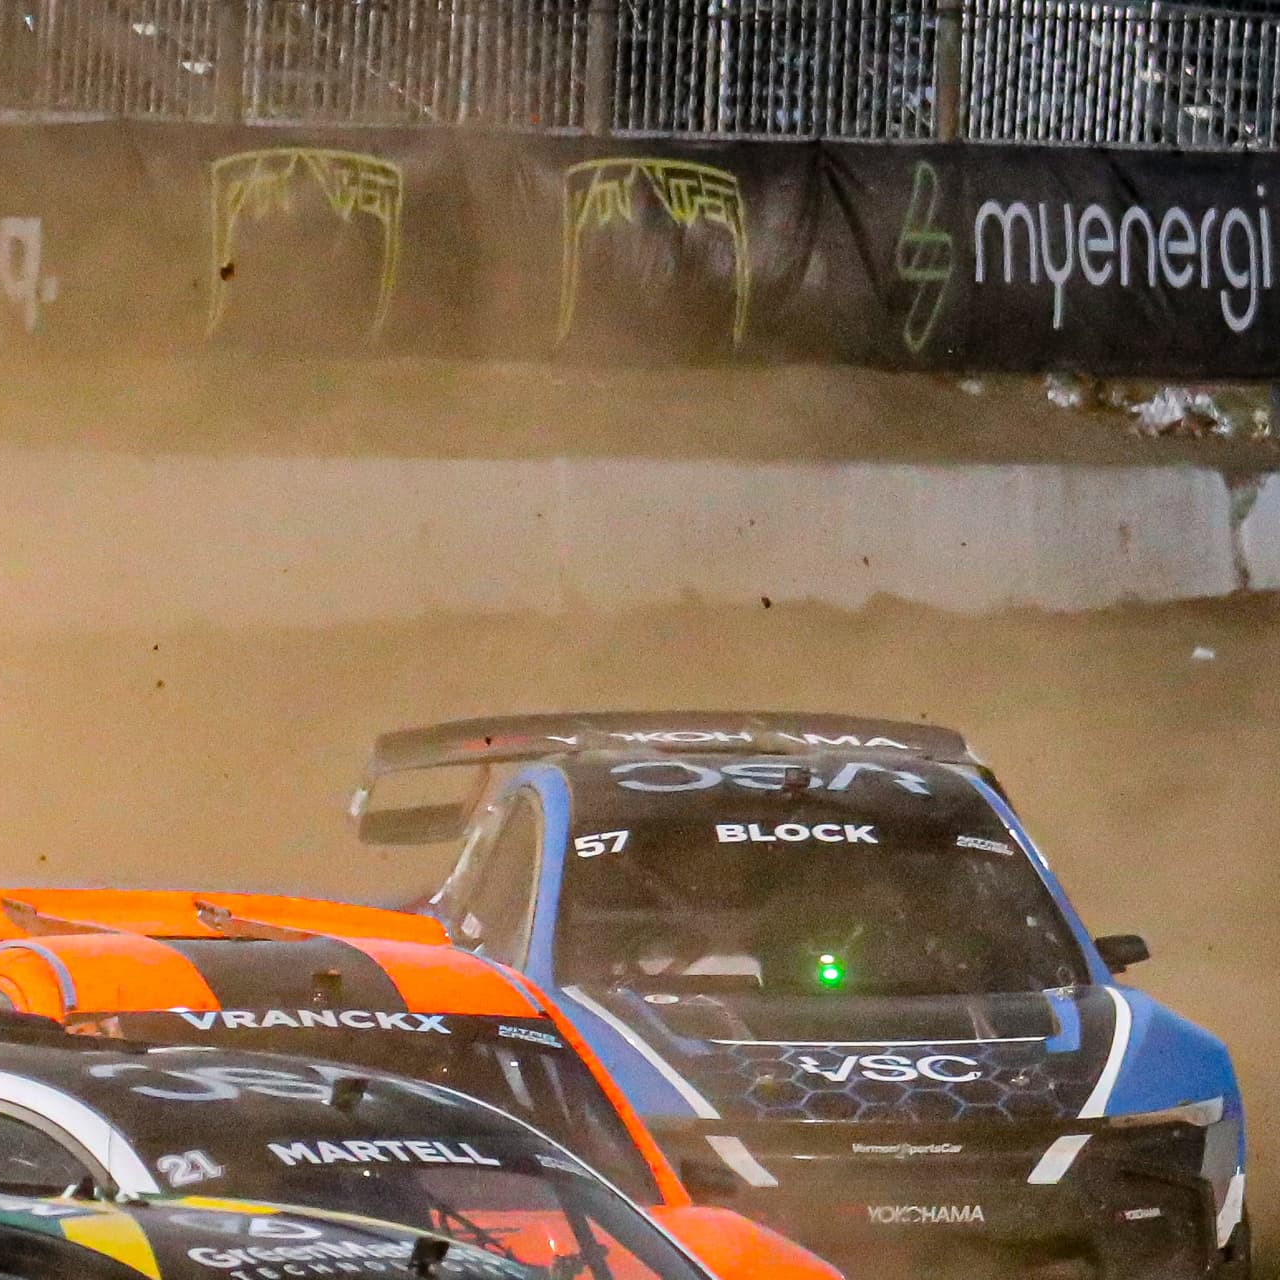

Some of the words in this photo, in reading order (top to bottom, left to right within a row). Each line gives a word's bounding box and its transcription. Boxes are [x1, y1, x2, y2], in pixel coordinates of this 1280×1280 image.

[974, 183, 1273, 333] myenergi
[573, 830, 630, 858] 57
[715, 822, 879, 844] BLOCK
[180, 1009, 453, 1035] VRANCKX
[797, 1054, 983, 1083] VSC
[157, 1149, 225, 1188] 21
[267, 1140, 502, 1167] MARTELL
[867, 1204, 986, 1224] YOKOHAMA
